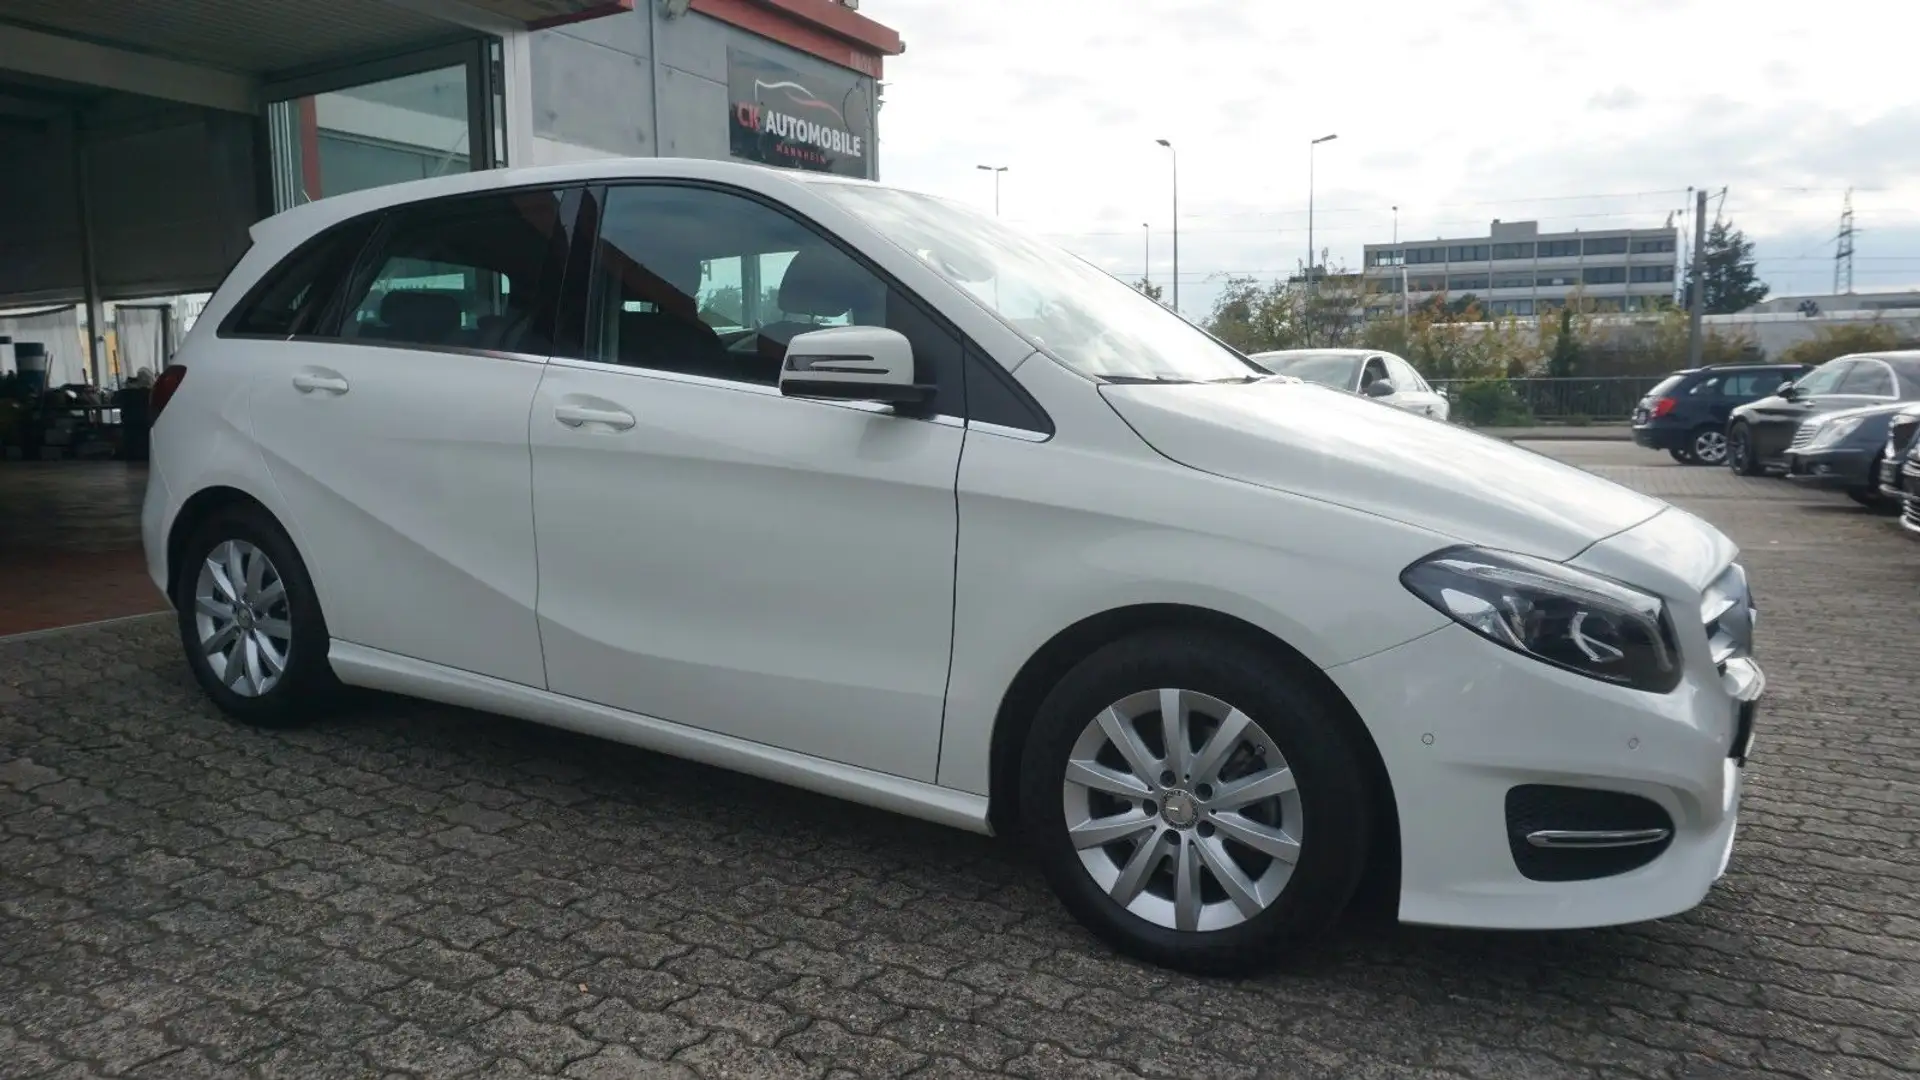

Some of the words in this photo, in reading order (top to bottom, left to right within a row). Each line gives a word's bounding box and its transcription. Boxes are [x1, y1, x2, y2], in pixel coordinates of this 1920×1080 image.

[737, 102, 760, 131] CK
[766, 110, 861, 157] AUTOMOBILE
[776, 143, 826, 163] MANNHEIM
